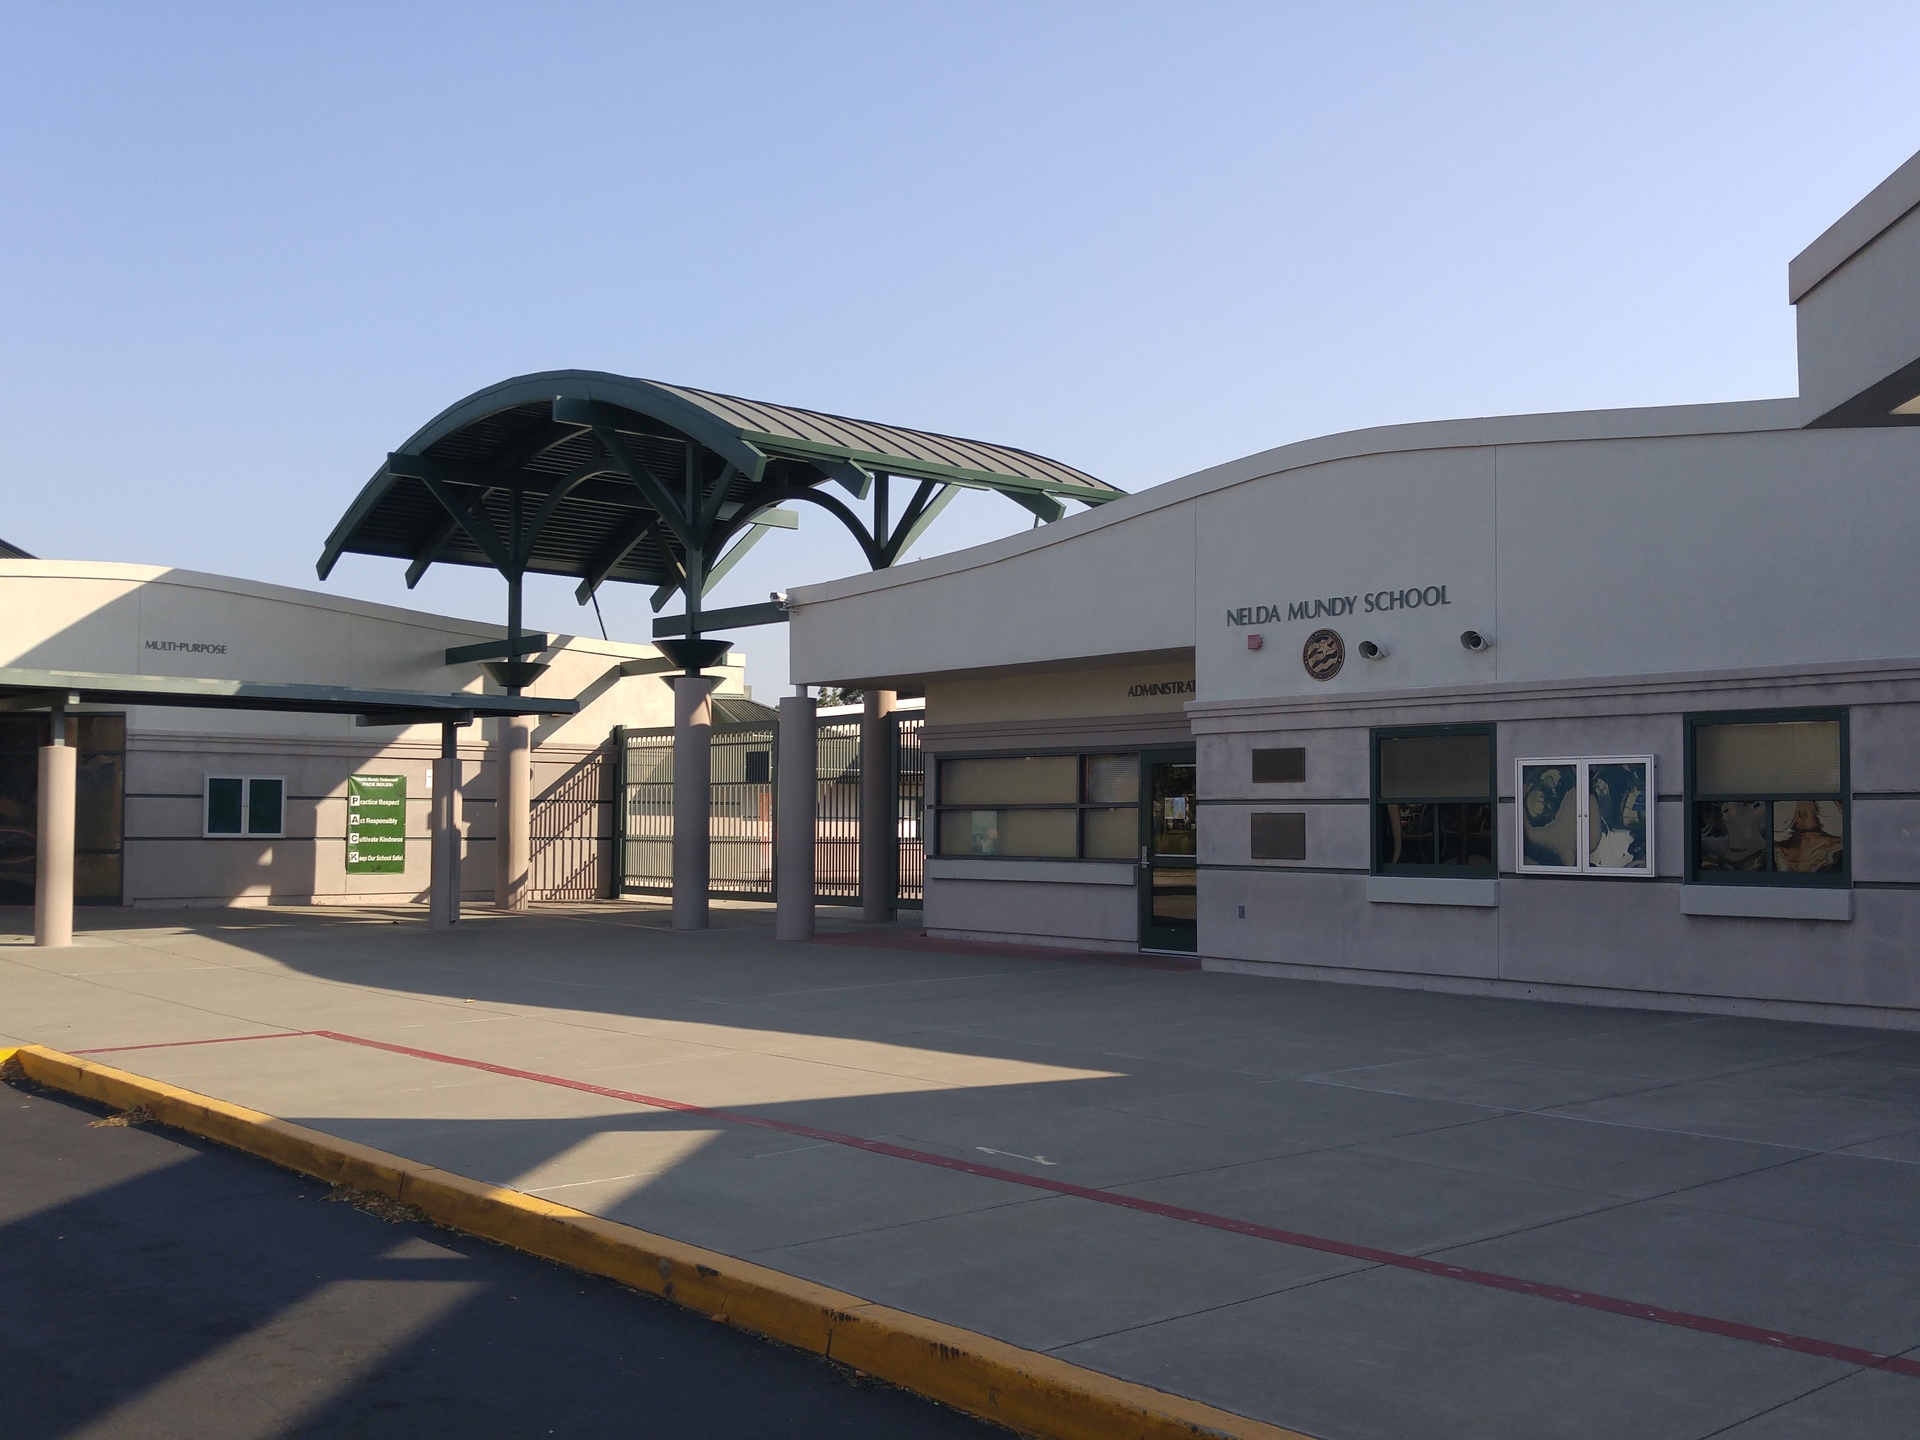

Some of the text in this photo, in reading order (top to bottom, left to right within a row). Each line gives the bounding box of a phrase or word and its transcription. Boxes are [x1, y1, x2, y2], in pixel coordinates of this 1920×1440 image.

[1226, 585, 1452, 627] NELDA MUNDY SCHOOL
[144, 640, 227, 655] MULTI-PURPOSE
[351, 814, 398, 826] Act Responsibly
